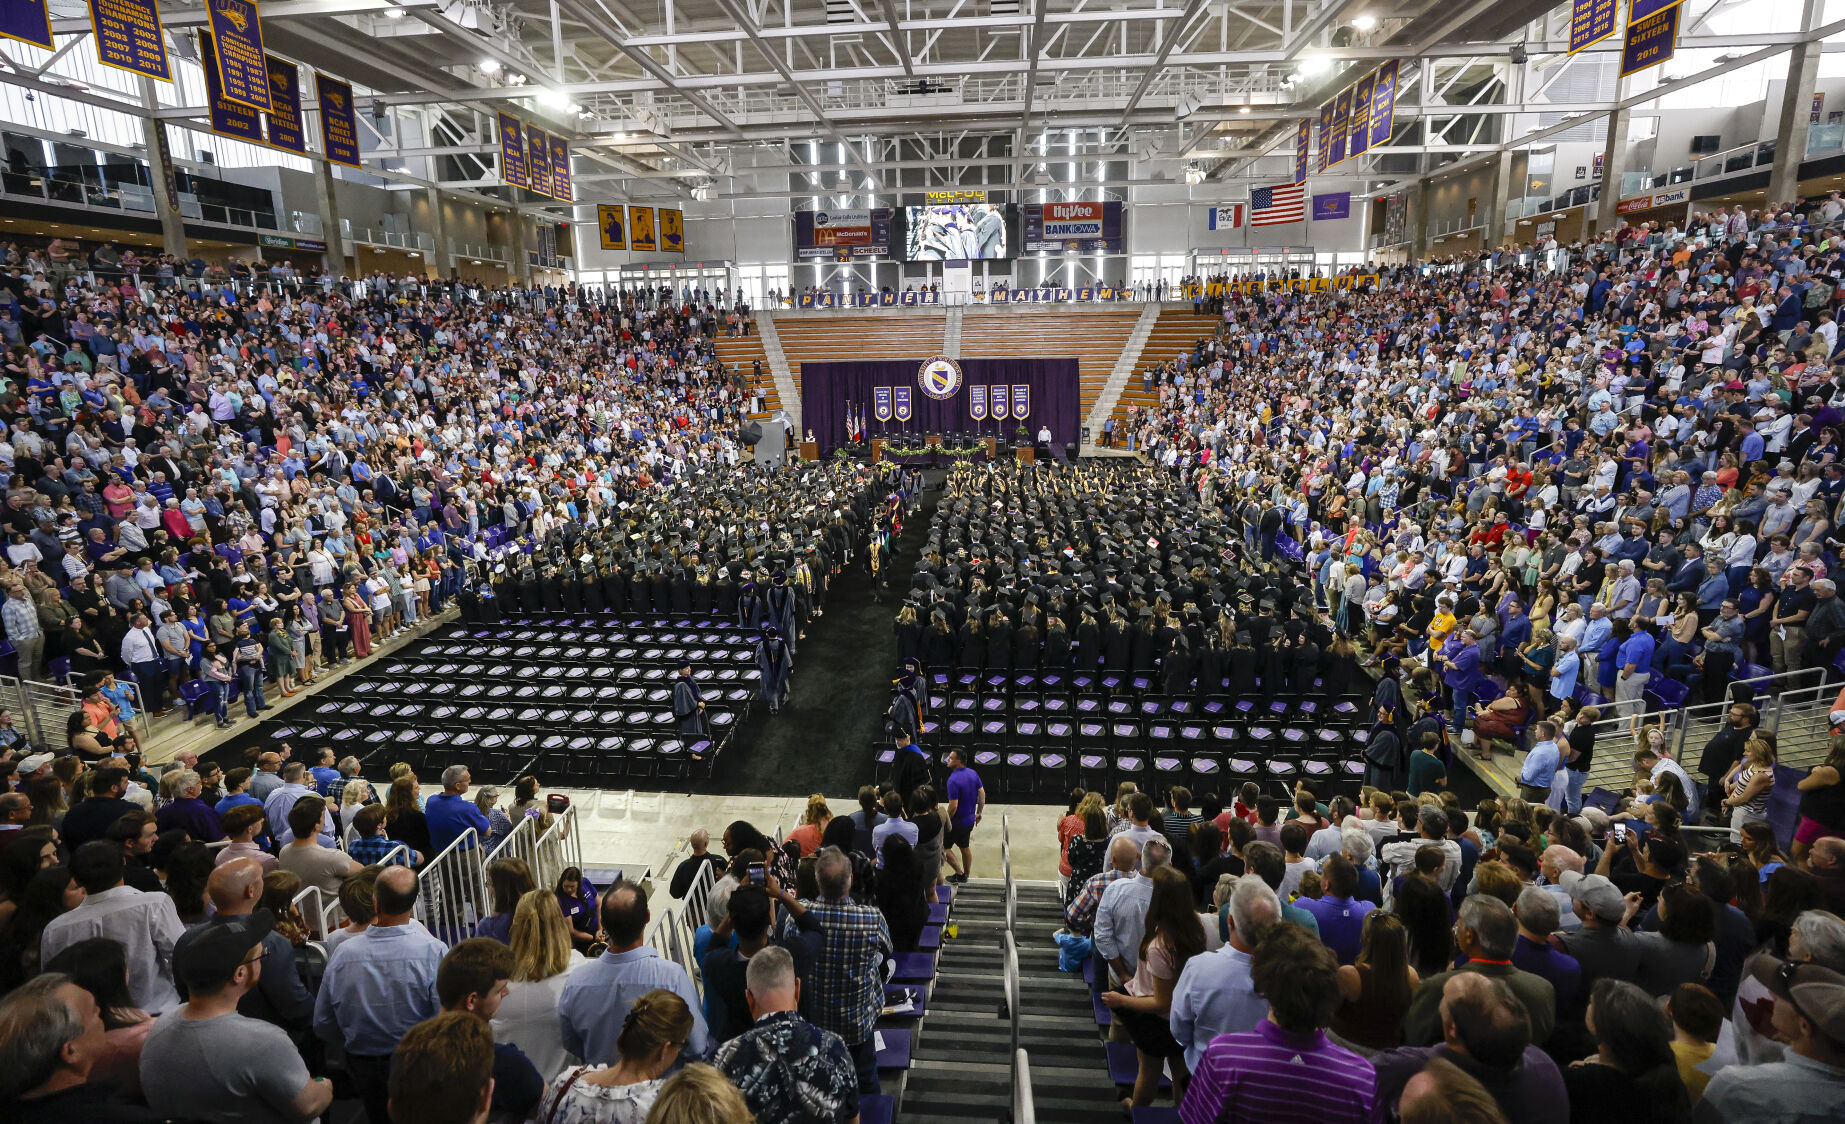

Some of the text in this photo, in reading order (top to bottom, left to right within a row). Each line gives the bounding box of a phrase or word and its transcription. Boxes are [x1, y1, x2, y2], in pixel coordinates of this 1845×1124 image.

[98, 0, 154, 22] TOURNAMENT
[98, 5, 156, 31] CHAMPIONS
[1594, 10, 1610, 24] 2010
[101, 17, 157, 41] 2001 2002
[1636, 11, 1668, 33] SWEET
[103, 28, 128, 42] 2003
[1573, 31, 1590, 44] 2015
[1630, 22, 1670, 45] SIXTEEN
[104, 39, 130, 52] 2007
[221, 35, 260, 54] CONFERENCE
[221, 41, 261, 61] TOURNAMENT
[223, 48, 262, 67] CHAMPIONS
[1636, 45, 1659, 62] 2010
[106, 50, 161, 72] 2010 2011
[217, 100, 254, 118] SIXTEEN
[272, 100, 293, 113] NCAA
[226, 118, 249, 130] 2002
[271, 116, 299, 131] SIXTEEN
[328, 116, 350, 130] NCAA
[329, 125, 351, 138] SWEET
[328, 133, 355, 147] SIXTEEN
[506, 147, 521, 158] NCAA
[802, 292, 935, 306] PANTHER
[993, 288, 1113, 300] MAYHEM
